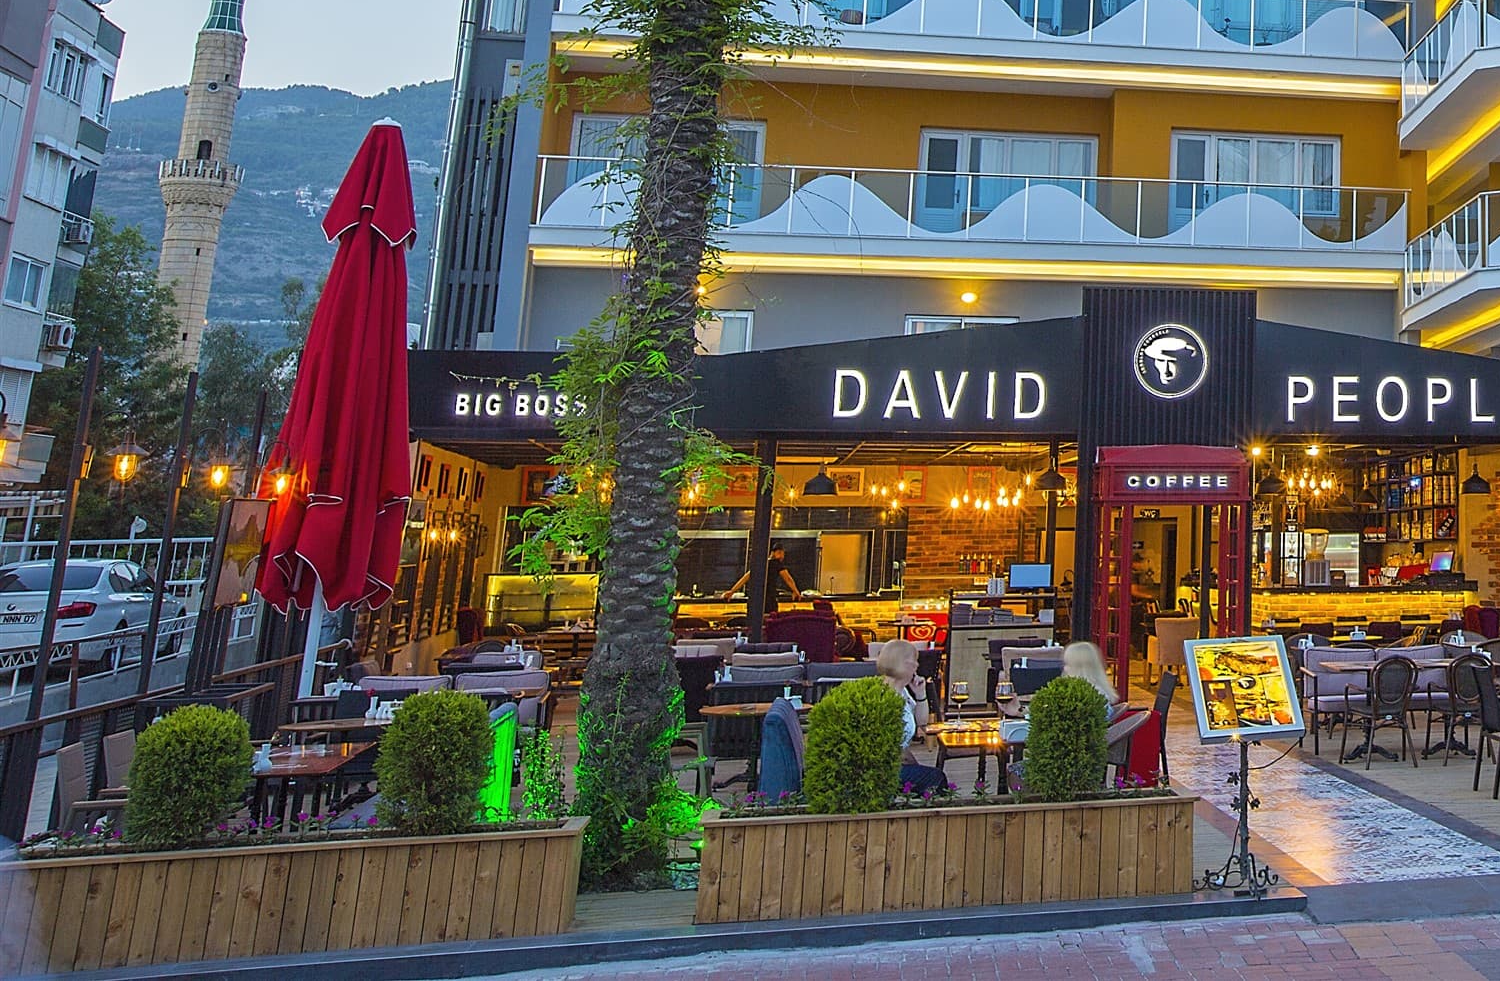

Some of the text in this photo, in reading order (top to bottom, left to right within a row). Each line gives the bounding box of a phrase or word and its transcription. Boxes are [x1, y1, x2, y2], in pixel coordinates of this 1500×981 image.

[455, 393, 502, 417] BIG
[832, 368, 1047, 420] DAVID
[1127, 475, 1228, 487] COFFEE
